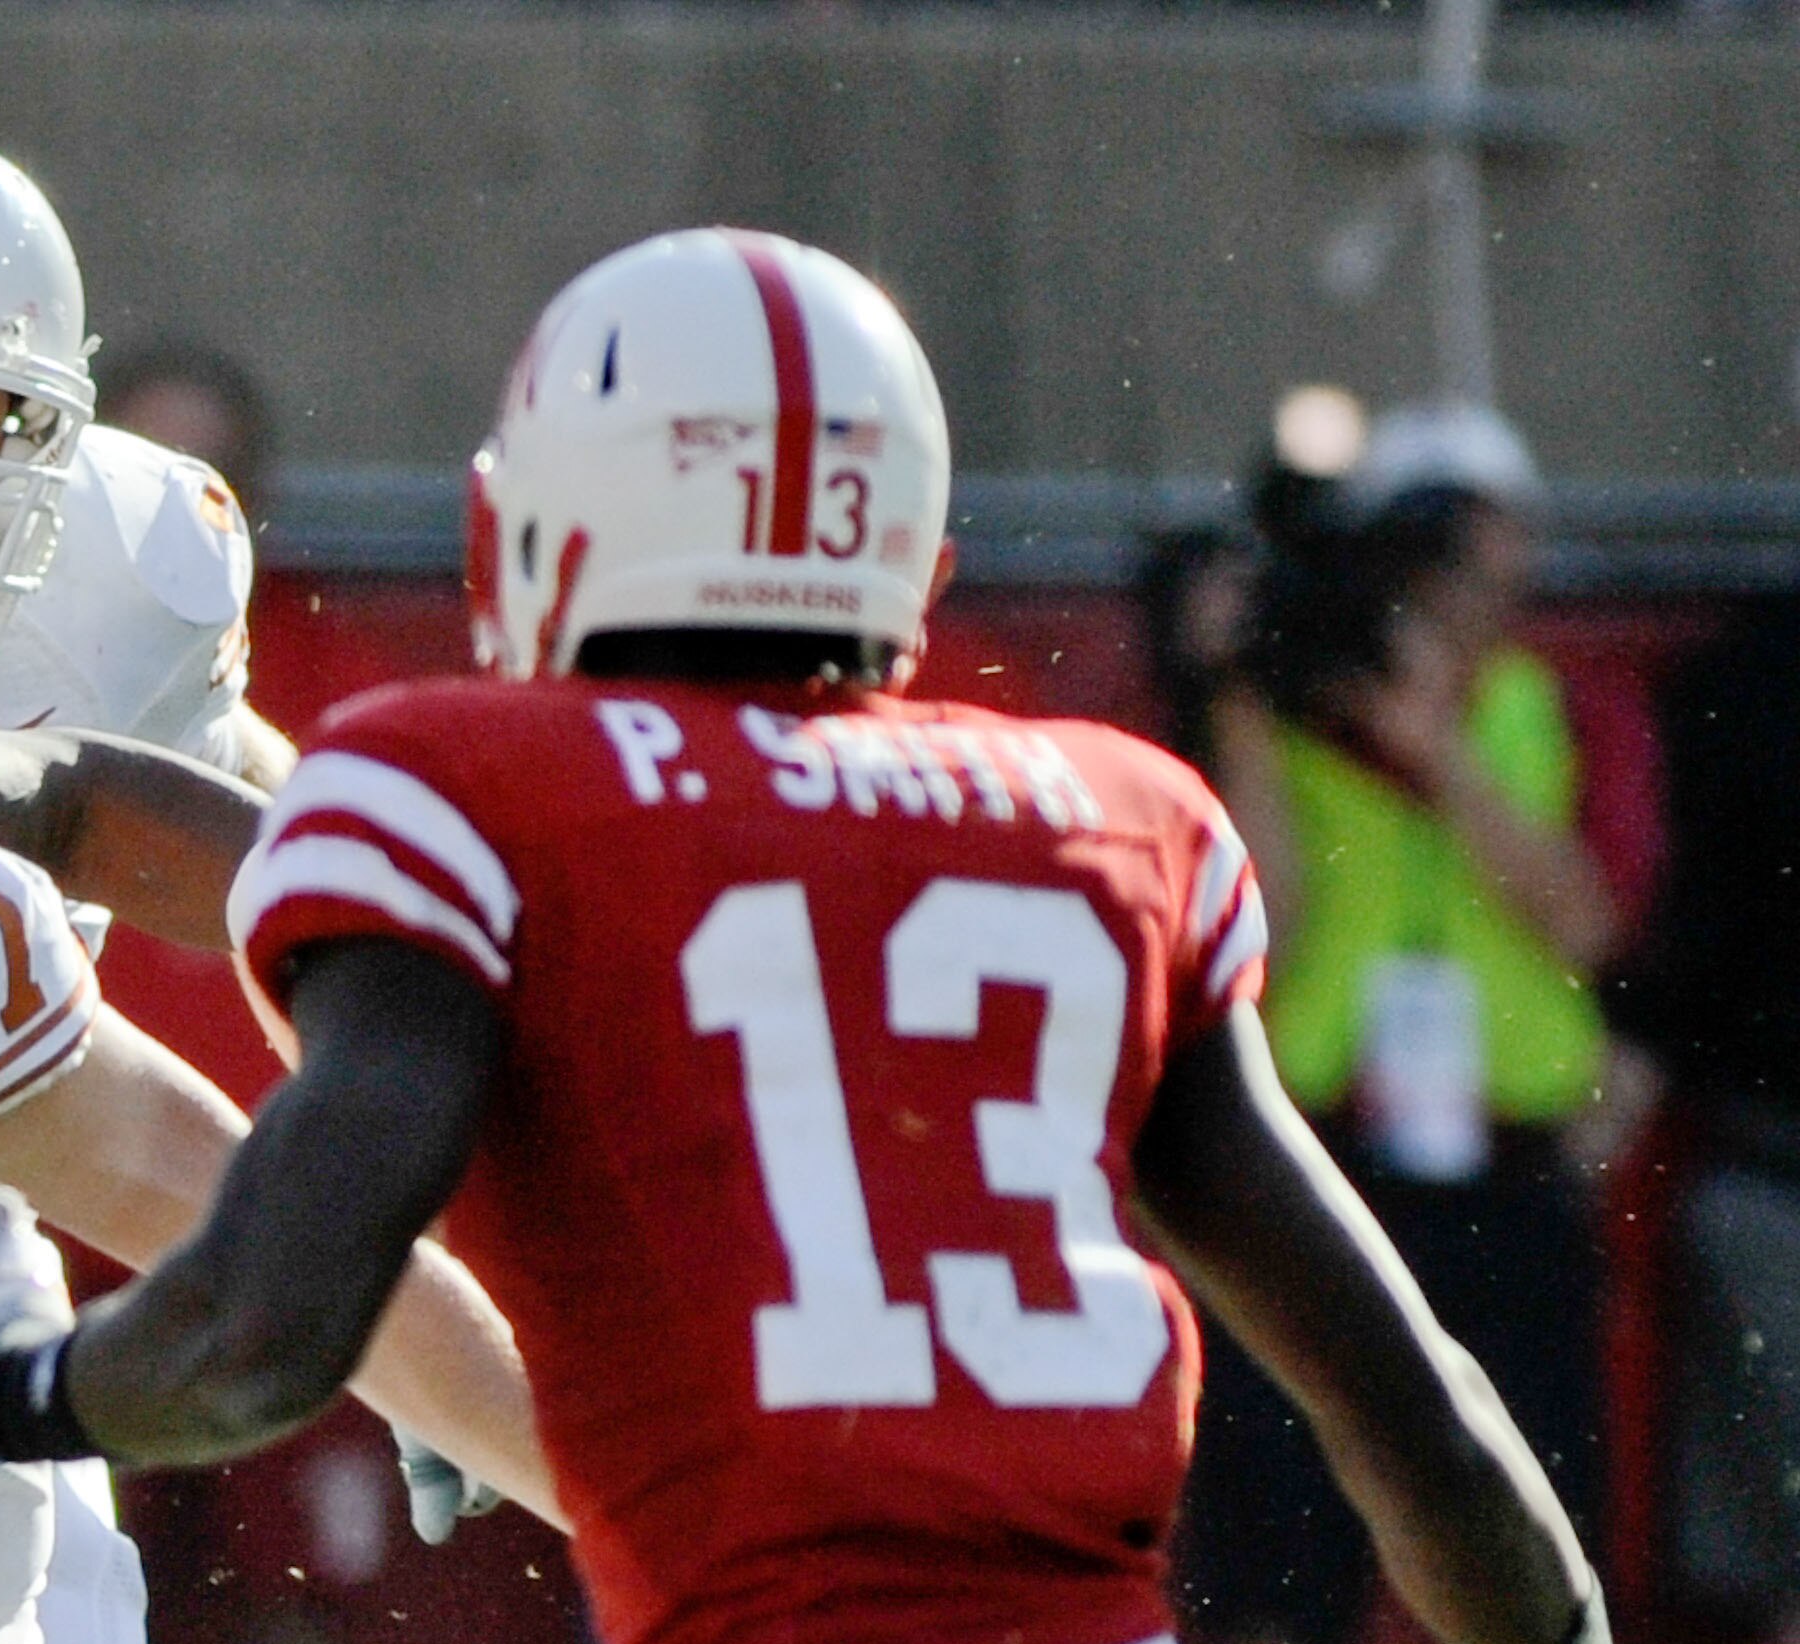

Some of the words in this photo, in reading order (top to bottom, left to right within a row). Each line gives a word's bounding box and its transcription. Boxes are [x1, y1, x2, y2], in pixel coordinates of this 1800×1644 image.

[597, 698, 708, 806] P.
[740, 704, 1105, 834] SMITH
[679, 874, 1171, 1411] 13
